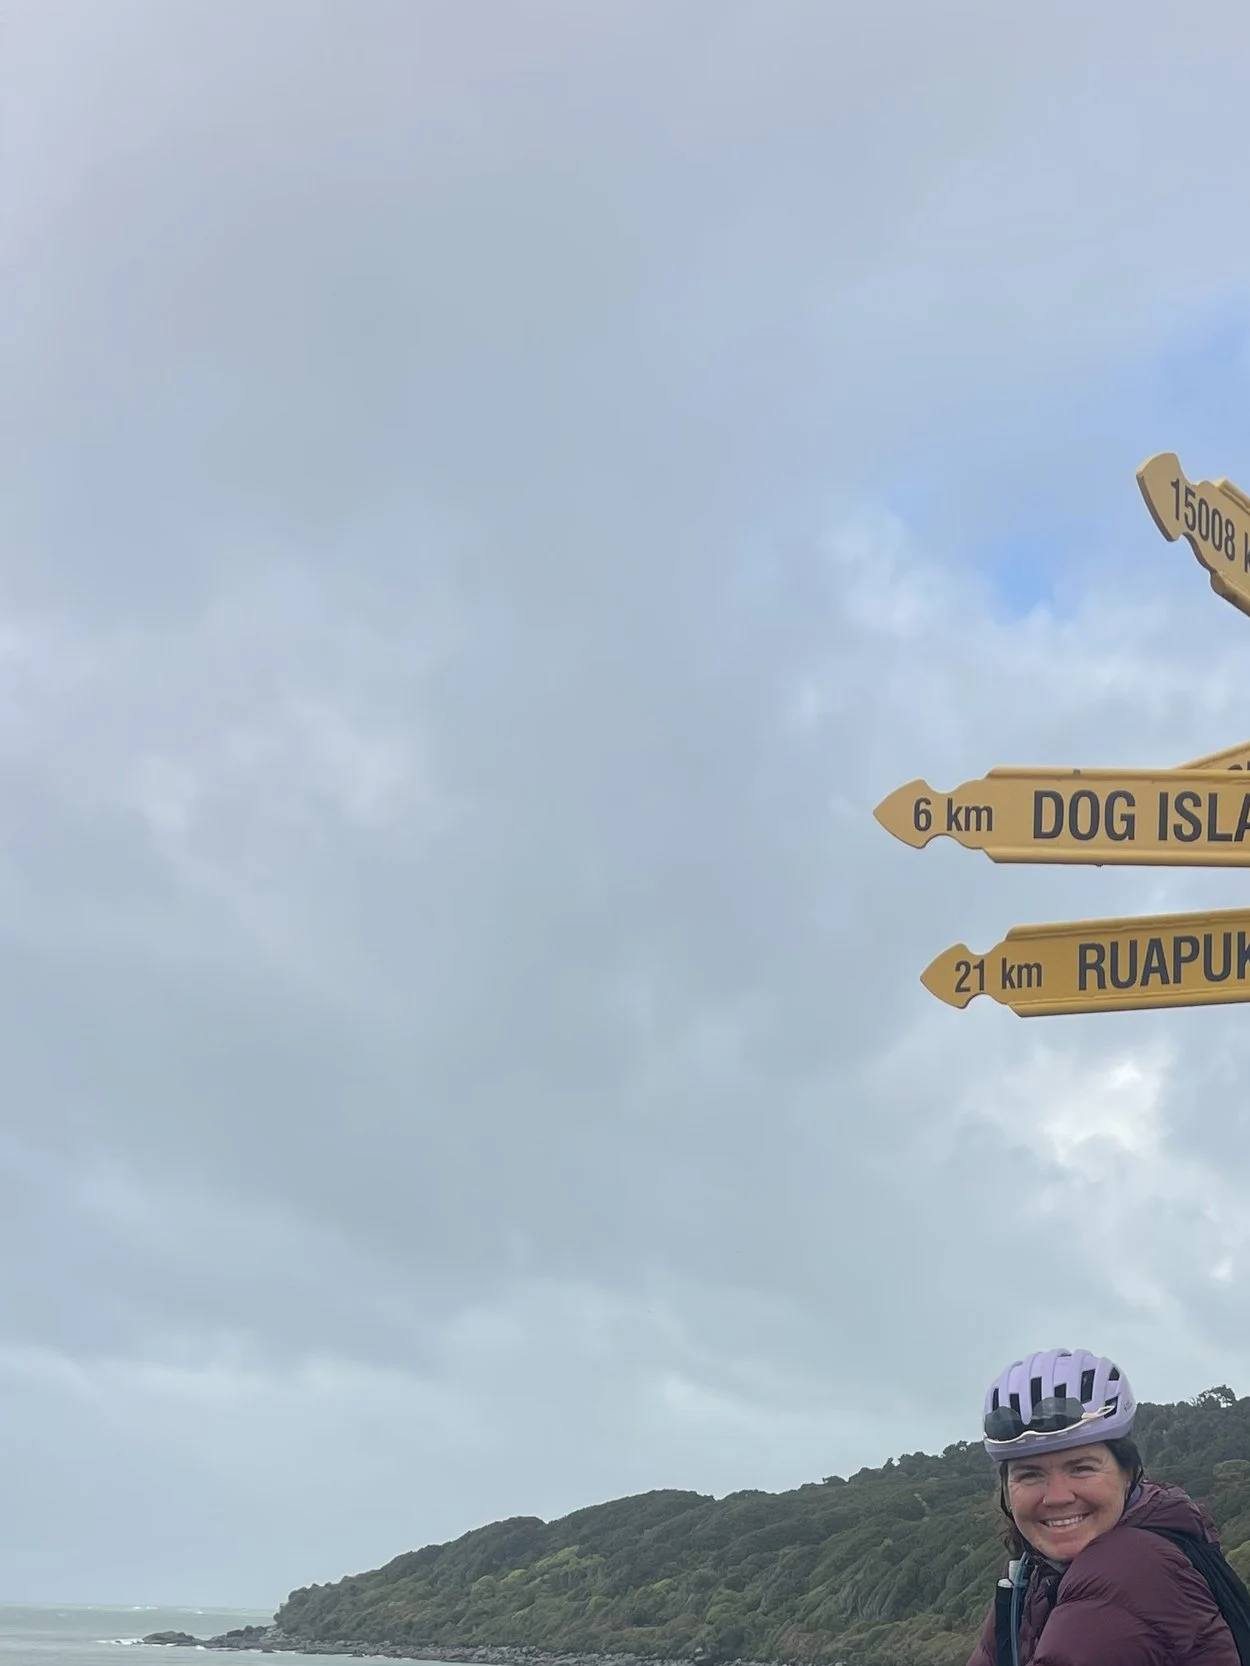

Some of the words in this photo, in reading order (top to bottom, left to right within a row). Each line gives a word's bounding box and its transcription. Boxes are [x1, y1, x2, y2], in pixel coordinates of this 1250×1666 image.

[1170, 476, 1237, 562] 15008
[913, 798, 932, 833] 6
[946, 798, 994, 833] km
[1032, 789, 1137, 841] DOG
[954, 959, 986, 994] 21
[1001, 956, 1043, 990] km
